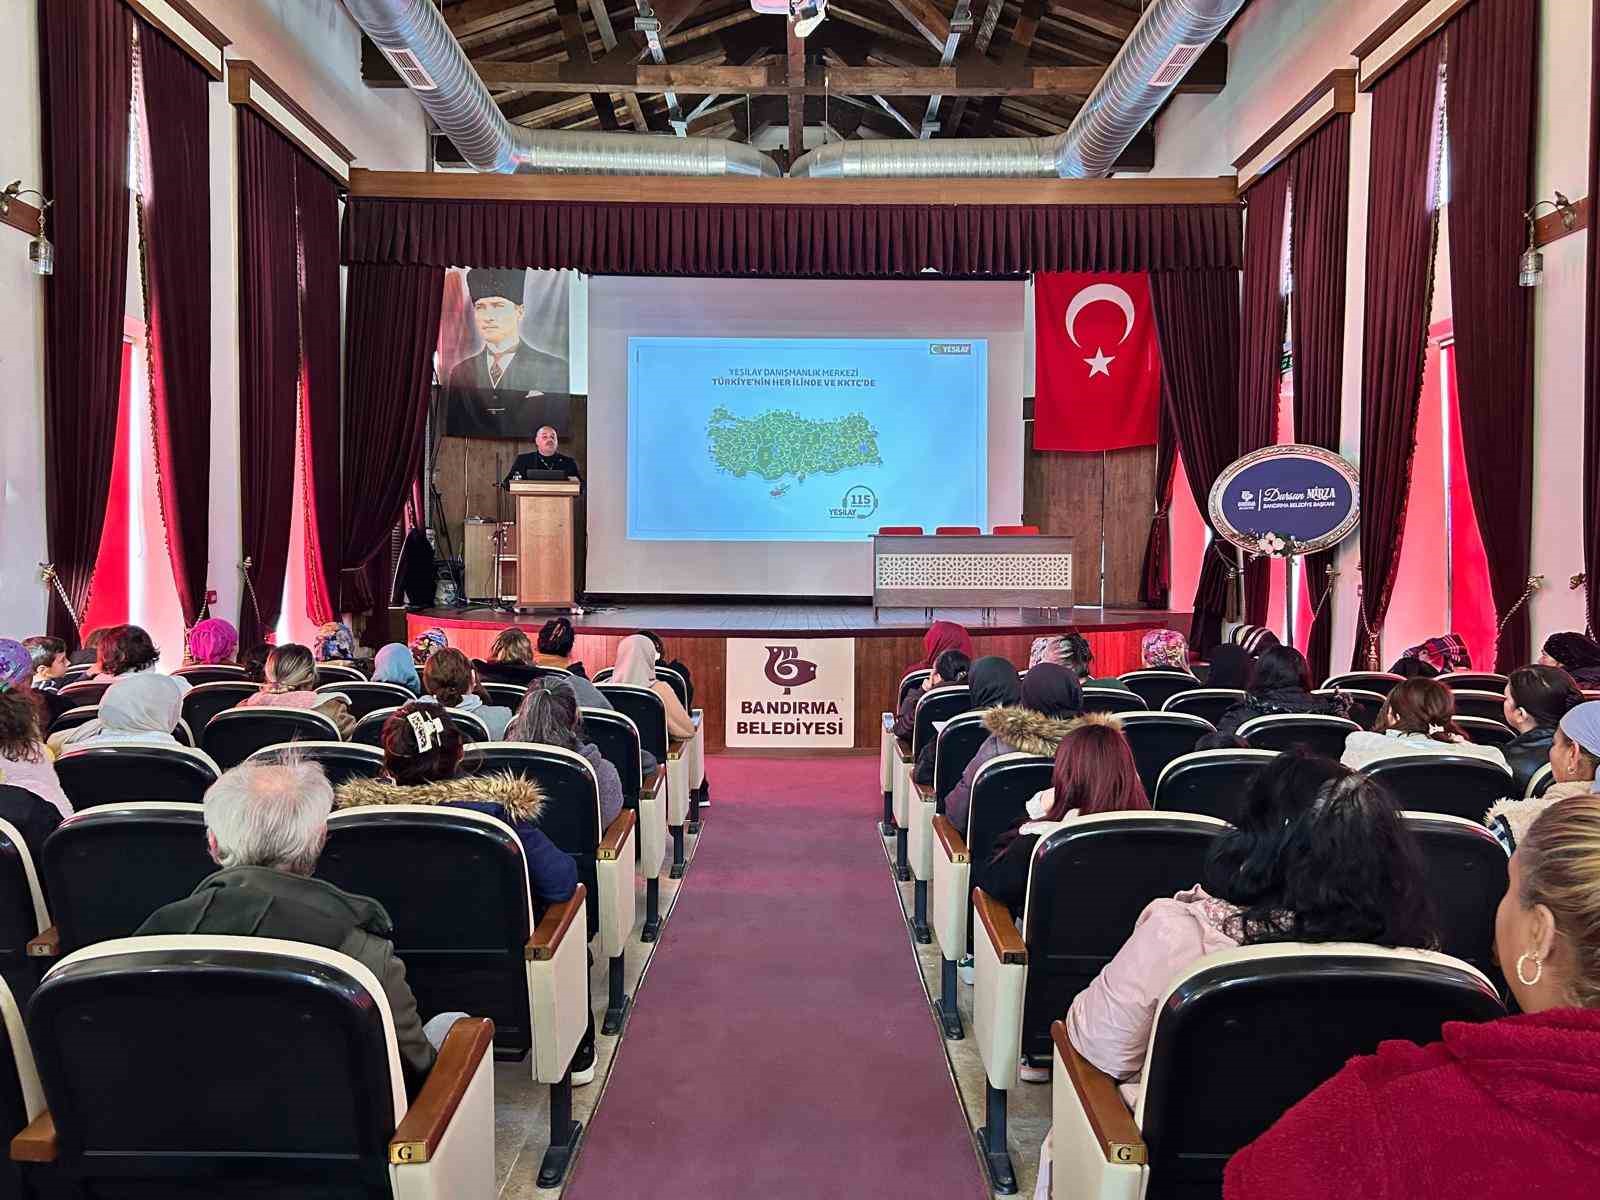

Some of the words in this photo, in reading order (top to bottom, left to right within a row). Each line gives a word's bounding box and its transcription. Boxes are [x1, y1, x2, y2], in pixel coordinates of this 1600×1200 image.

[772, 377, 791, 386] HER
[824, 378, 837, 387] VE
[851, 494, 871, 505] 115
[1263, 487, 1305, 502] Dursun
[741, 701, 839, 714] BANDIRMA
[736, 718, 843, 735] BELEDİYESİ
[397, 1145, 412, 1160] G
[1117, 1146, 1131, 1161] G
